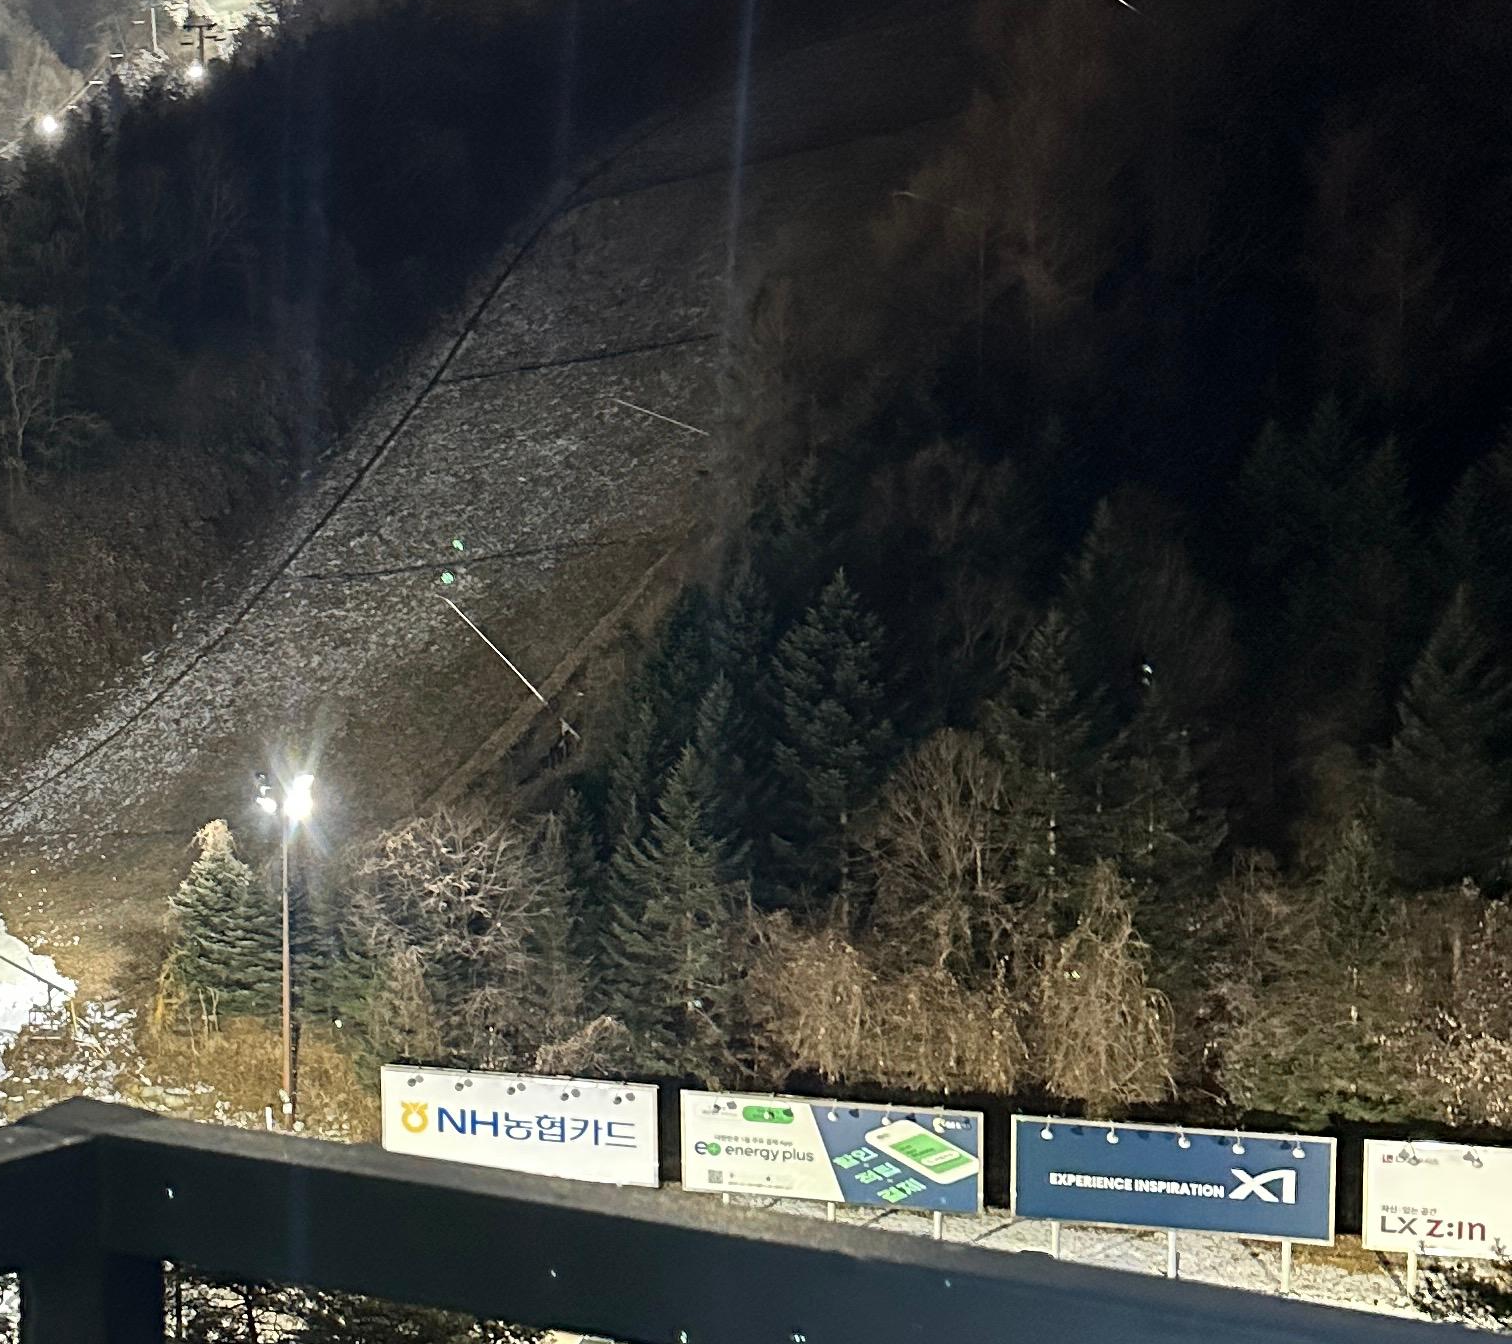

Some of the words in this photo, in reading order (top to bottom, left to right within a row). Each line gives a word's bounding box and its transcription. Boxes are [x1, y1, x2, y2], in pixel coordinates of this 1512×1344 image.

[438, 1106, 637, 1149] NH농협카드
[725, 1144, 779, 1162] energy
[781, 1146, 815, 1163] plus
[1049, 1171, 1133, 1192] EXPERIENCE
[1134, 1179, 1225, 1199] INSPIRATION
[1380, 1215, 1418, 1236] LX
